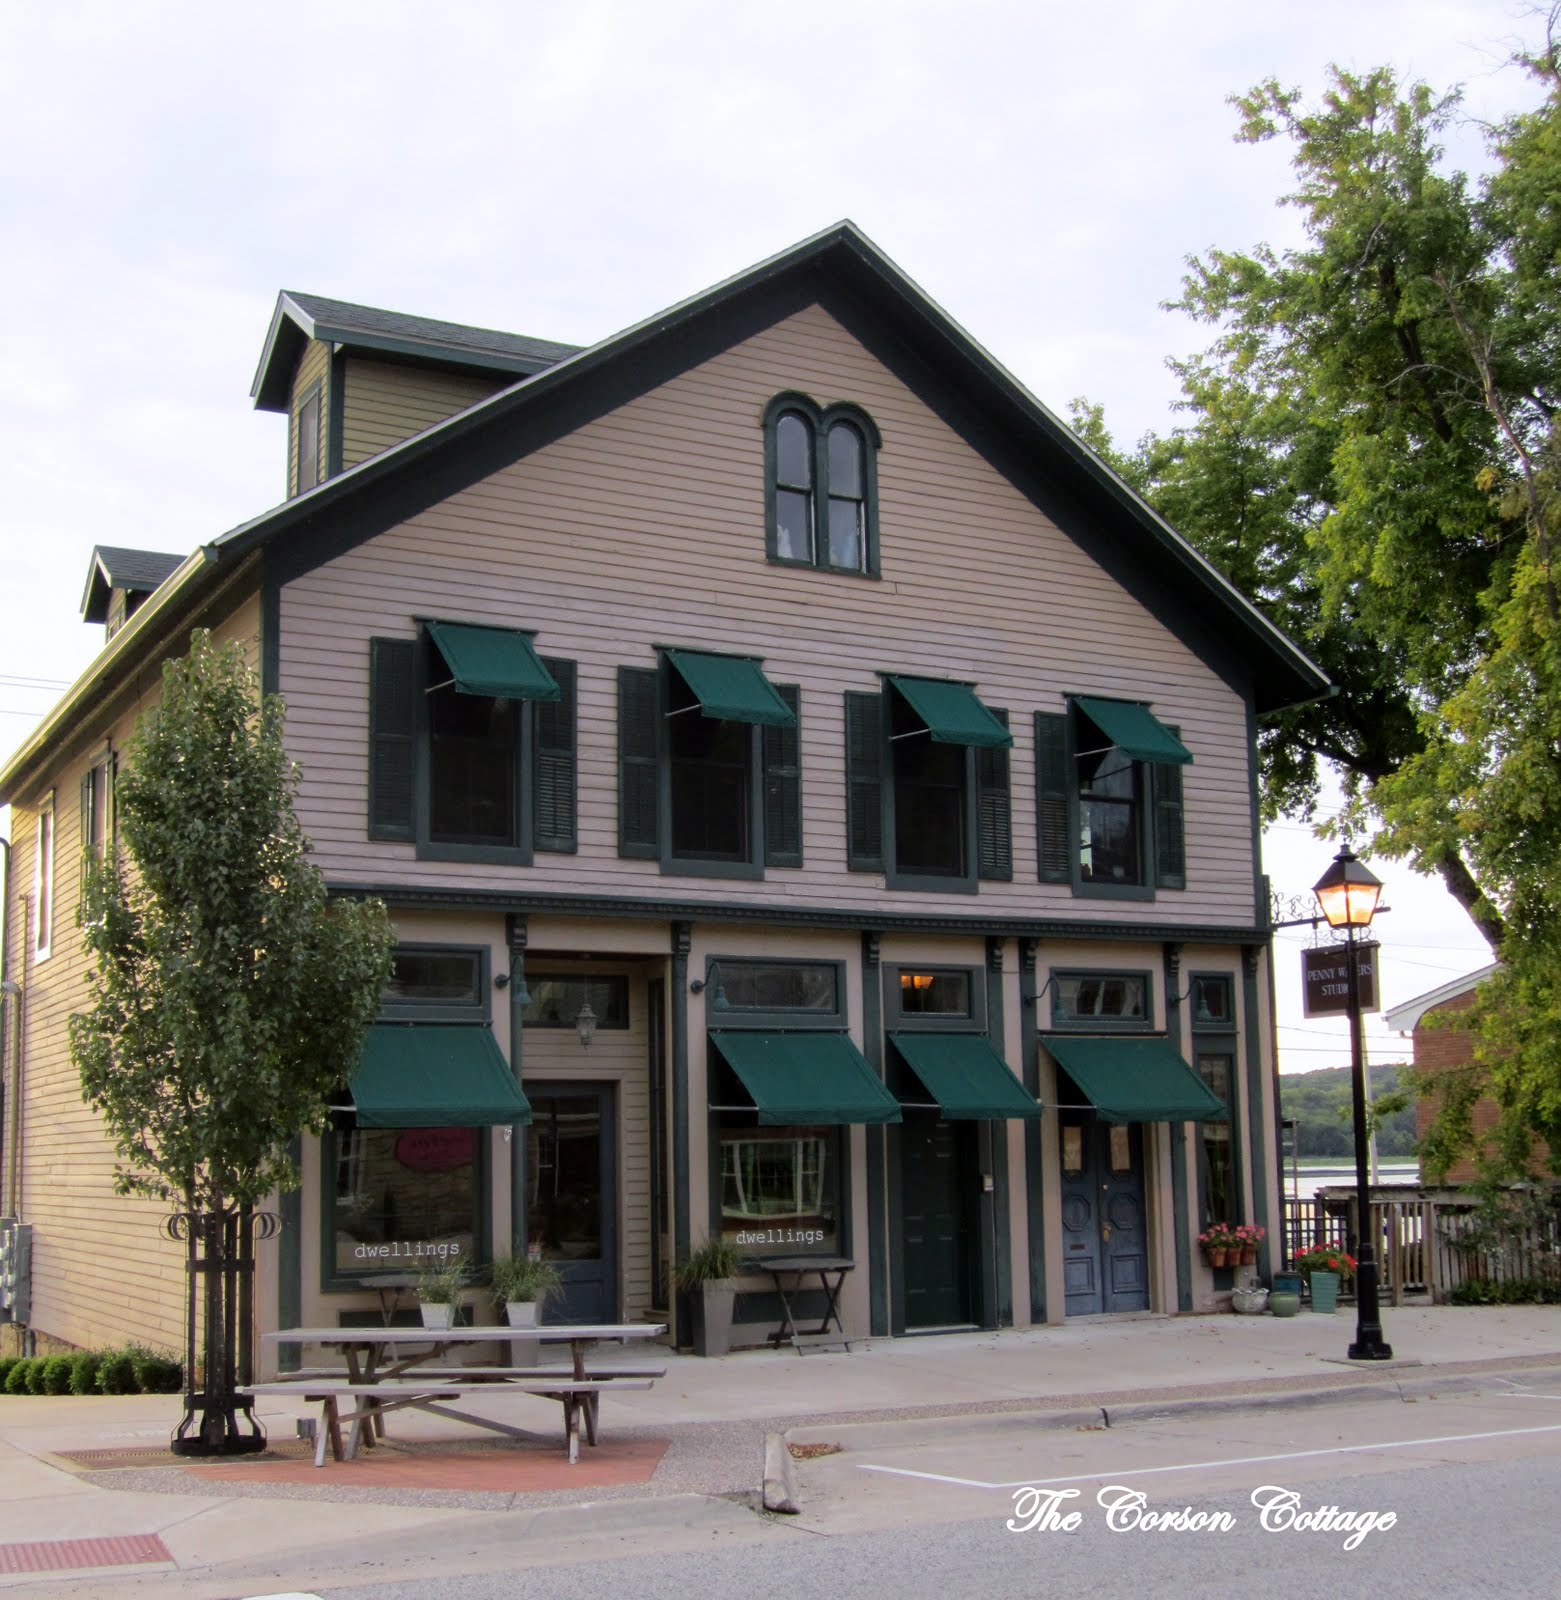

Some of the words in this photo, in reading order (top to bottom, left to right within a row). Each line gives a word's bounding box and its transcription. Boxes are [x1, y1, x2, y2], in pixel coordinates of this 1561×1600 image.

[1307, 967, 1336, 981] PENNY
[1338, 964, 1373, 978] WERS
[736, 1229, 824, 1245] dwellings
[354, 1241, 460, 1259] dwellings
